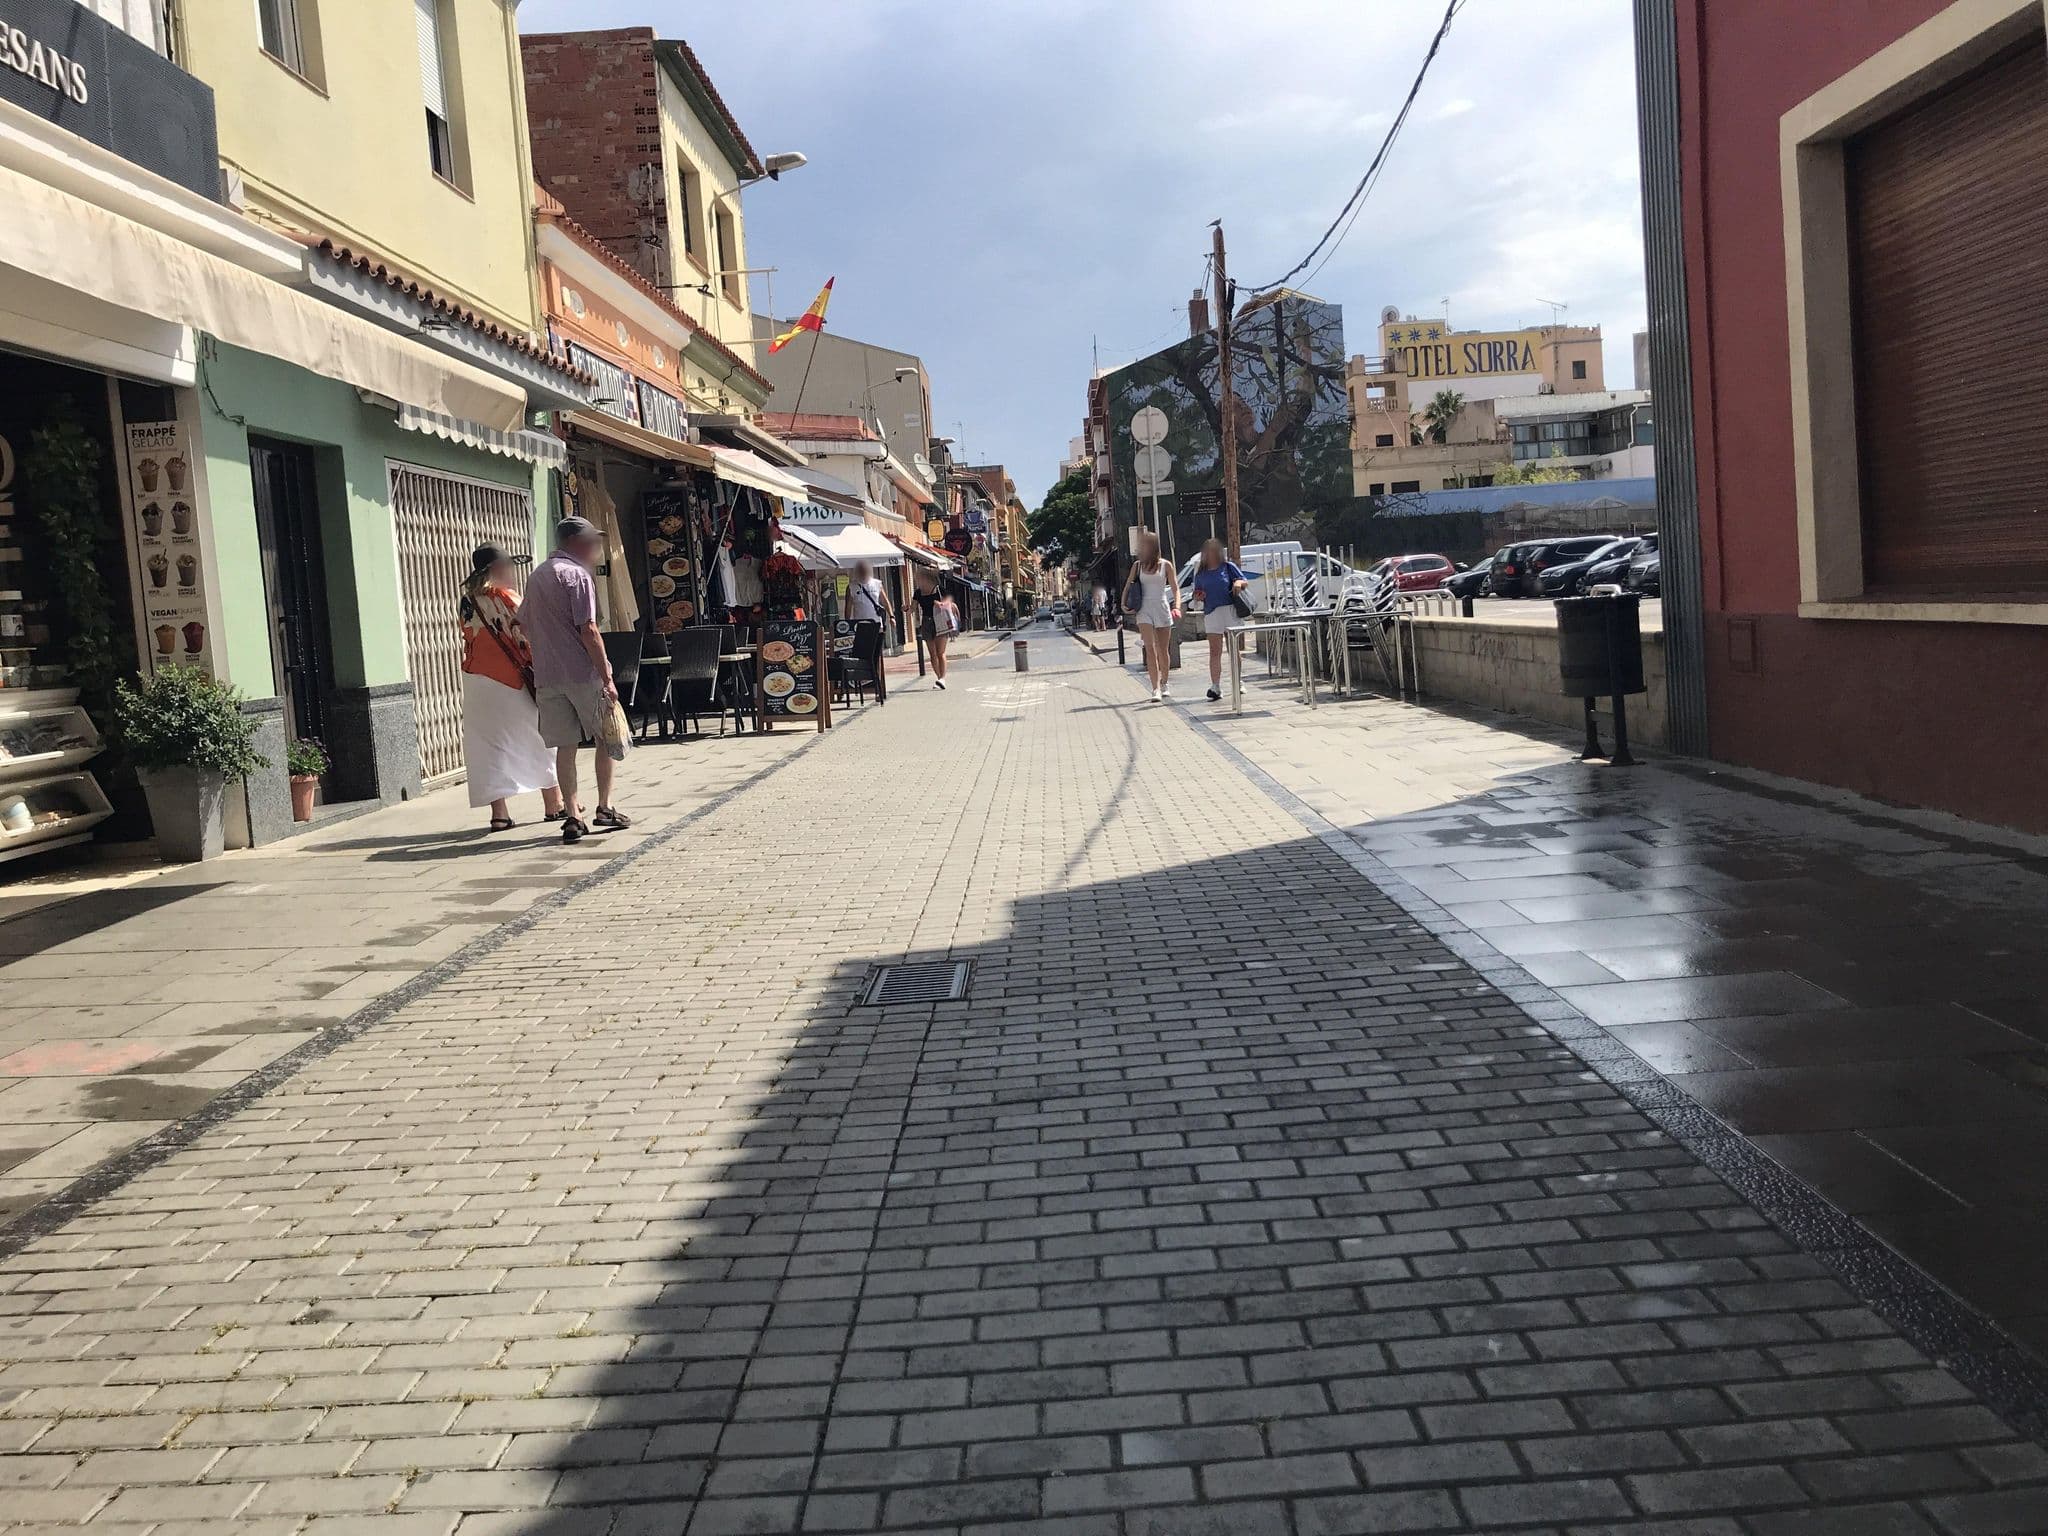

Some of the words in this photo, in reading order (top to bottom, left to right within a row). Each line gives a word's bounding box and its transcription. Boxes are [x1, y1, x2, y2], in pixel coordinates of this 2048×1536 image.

[1389, 343, 1458, 377] OTEL
[1464, 340, 1536, 374] SORRA
[131, 424, 176, 438] FRAPPÉ
[132, 436, 174, 448] GELATO
[151, 608, 177, 617] VEGAN
